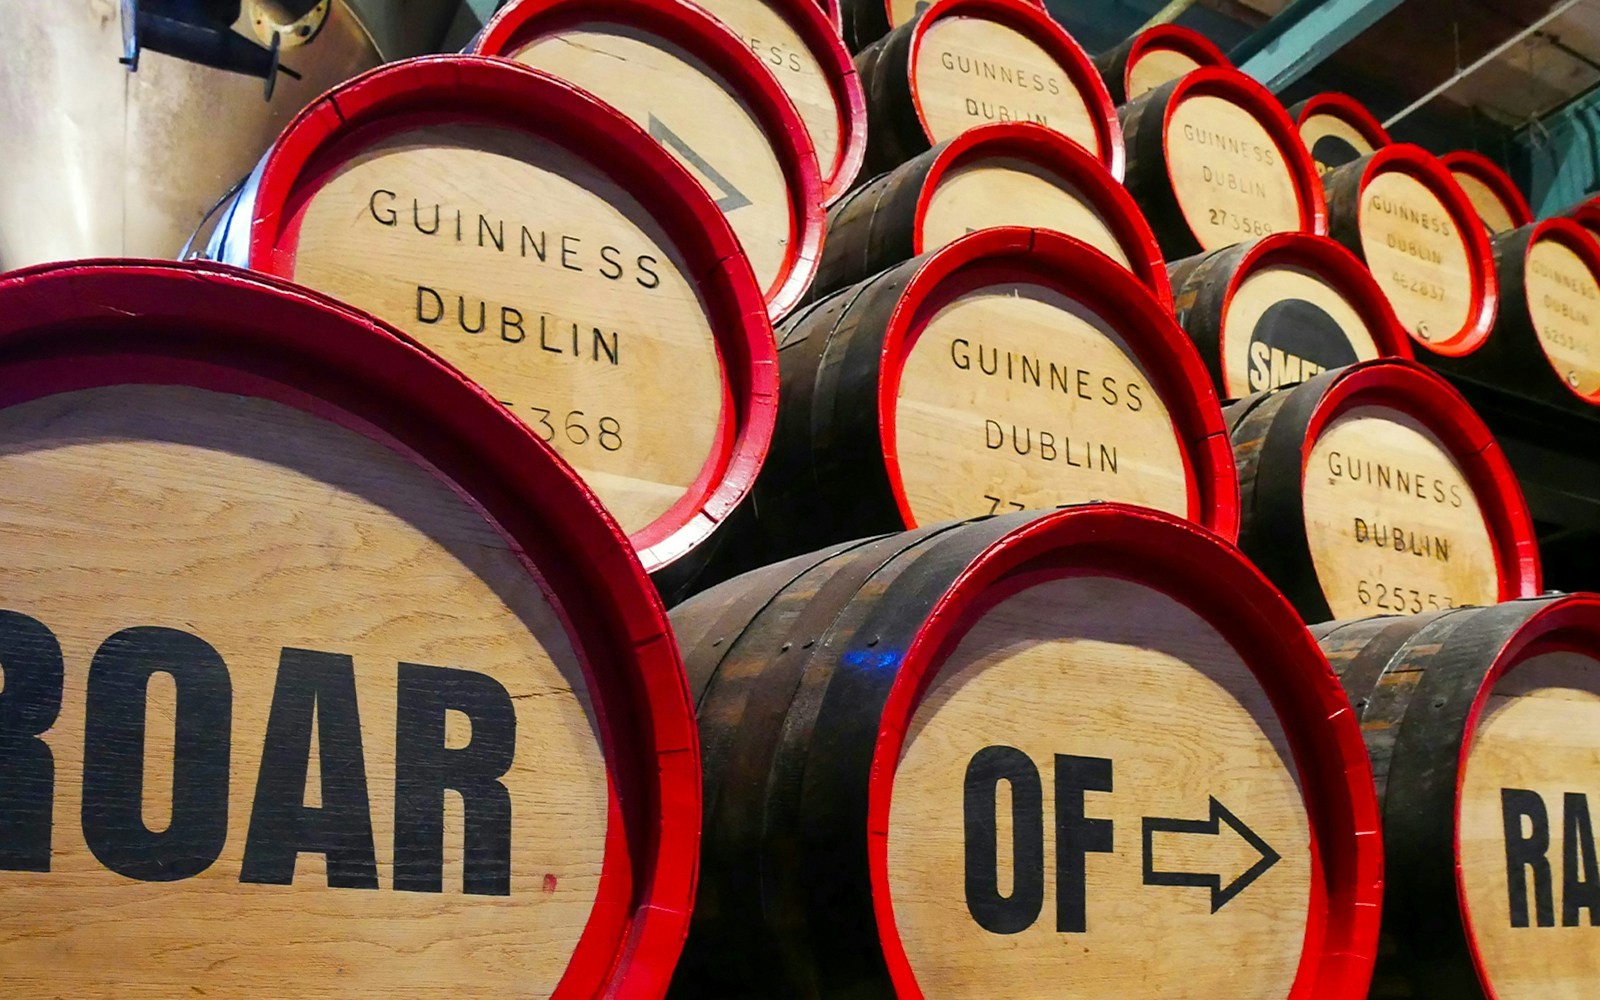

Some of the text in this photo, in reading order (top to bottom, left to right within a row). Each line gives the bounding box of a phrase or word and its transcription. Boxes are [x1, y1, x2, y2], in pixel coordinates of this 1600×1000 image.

[742, 35, 801, 72] ESS
[941, 51, 1060, 95] GUINNESS
[1184, 124, 1274, 166] GUINNESS
[1203, 165, 1266, 198] DUBLIN
[1208, 208, 1273, 237] 273589
[1372, 195, 1450, 237] GUINNESS
[370, 189, 660, 289] GUINNESS
[1387, 233, 1442, 265] DUBLIN
[1531, 259, 1597, 300] GUINNESS
[416, 286, 618, 365] DUBLIN
[1543, 294, 1590, 326] DUBLIN
[951, 339, 1142, 412] GUINNESS
[1250, 341, 1326, 390] SM
[500, 401, 622, 451] 368
[986, 419, 1118, 474] DUBLIN
[1328, 451, 1463, 508] GUINNESS
[1354, 517, 1449, 561] DUBLIN
[963, 745, 1115, 934] OF
[1501, 787, 1600, 928] RA
